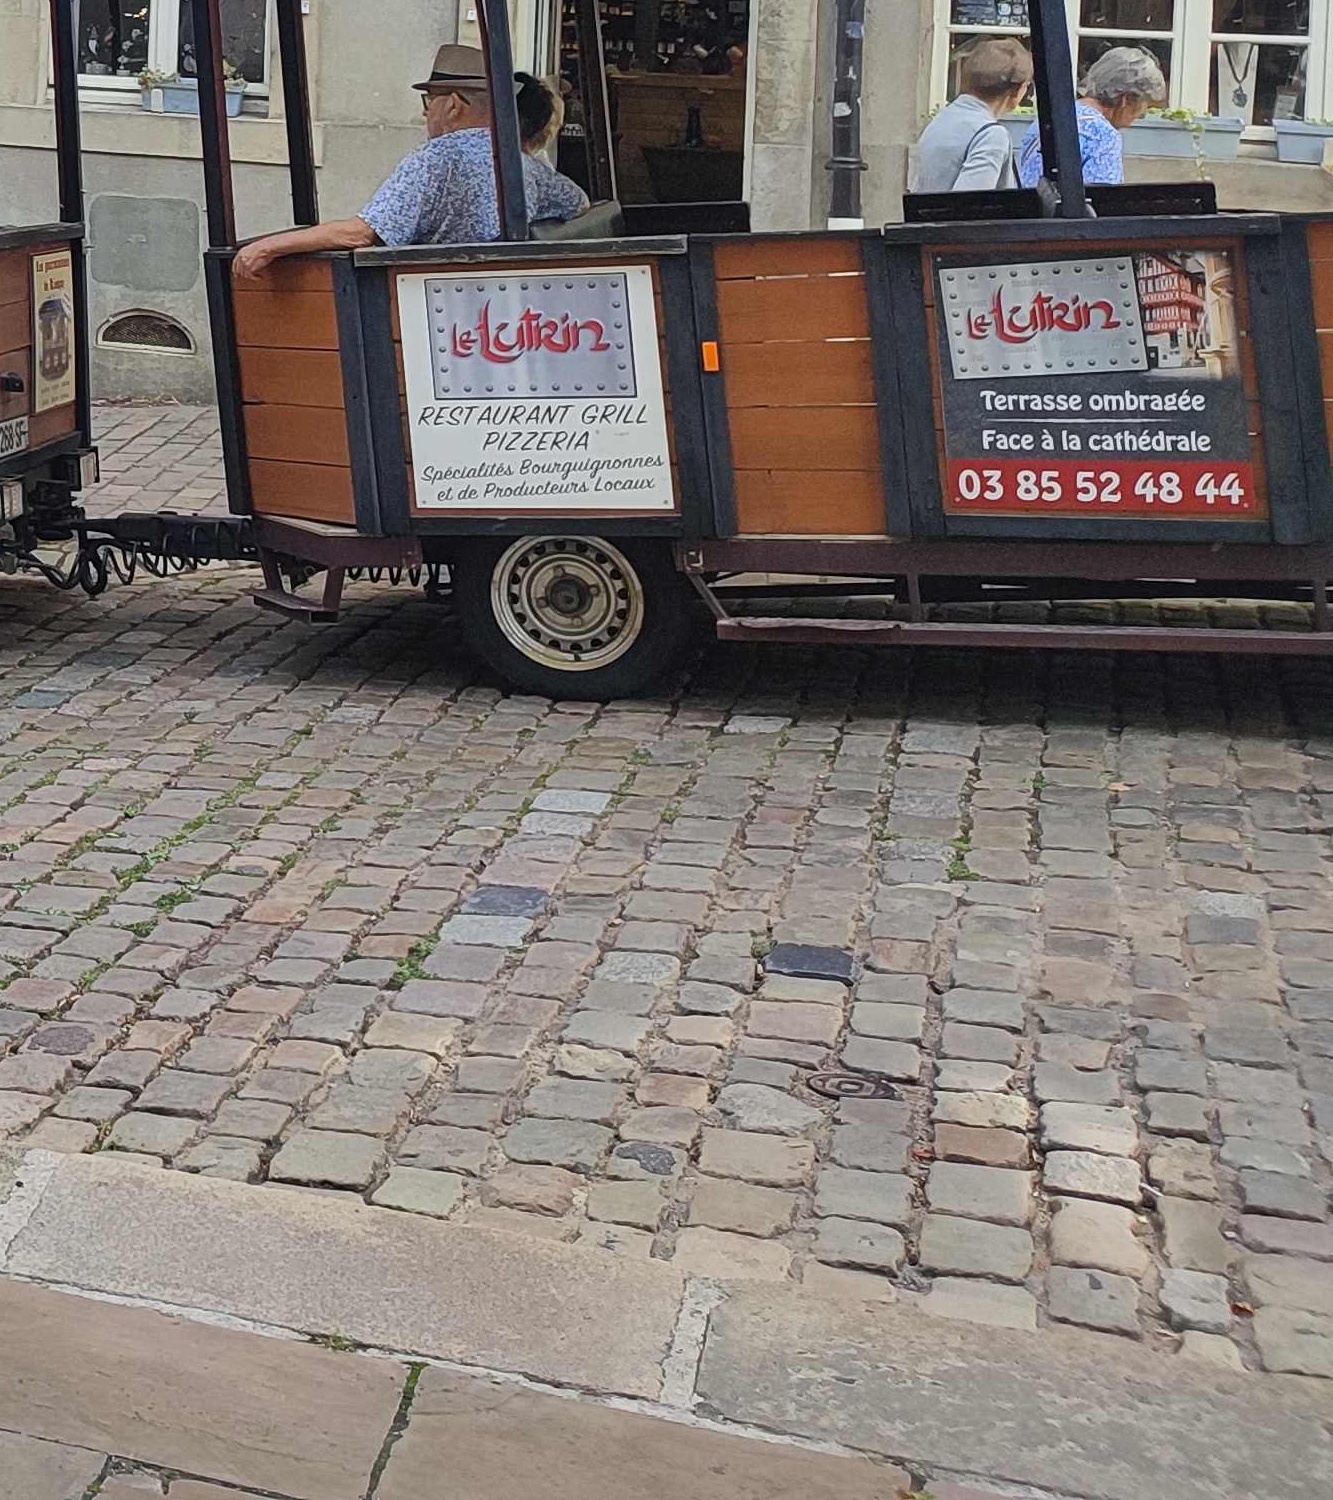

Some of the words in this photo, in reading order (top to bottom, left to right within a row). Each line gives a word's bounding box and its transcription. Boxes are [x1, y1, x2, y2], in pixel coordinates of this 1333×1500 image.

[967, 307, 992, 340] Le
[989, 283, 1121, 344] Lutrin
[450, 322, 478, 358] Le
[475, 297, 611, 364] Lutrin
[979, 390, 1083, 412] Terrasse
[1088, 389, 1206, 412] ombragée
[417, 404, 576, 426] RESTAURANT
[582, 403, 649, 426] GRILL
[482, 430, 591, 451] PIZZERIA
[981, 429, 1034, 450] Face
[1041, 428, 1055, 451] à
[1062, 431, 1082, 451] la
[1088, 429, 1212, 452] cathédrale
[420, 462, 515, 486] Spécialités
[518, 455, 665, 481] Bourguignonnes
[437, 487, 454, 502] et
[457, 484, 479, 500] de
[483, 480, 590, 499] Producteurs
[594, 476, 656, 492] Locaux
[958, 468, 1004, 501] 03
[1015, 470, 1063, 501] 85
[1076, 470, 1122, 503] 52
[1134, 471, 1183, 504] 48
[1194, 472, 1245, 505] 44
